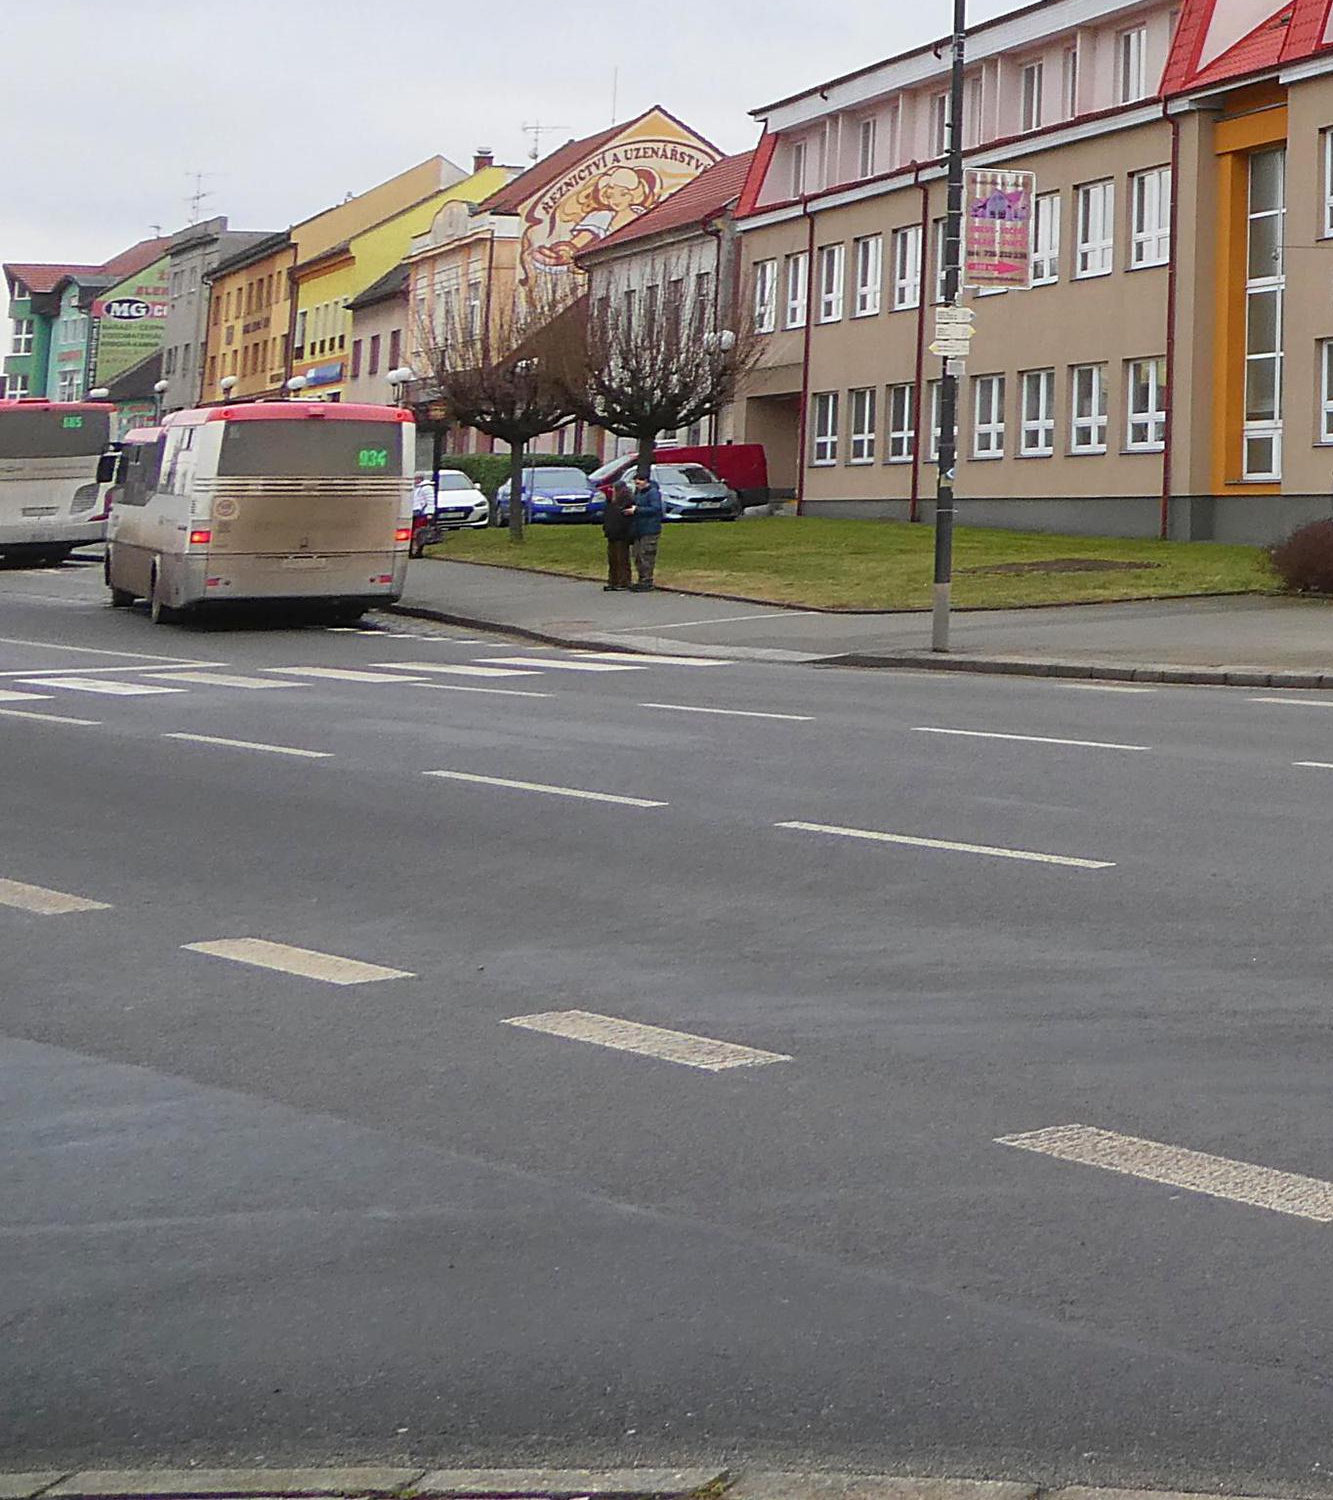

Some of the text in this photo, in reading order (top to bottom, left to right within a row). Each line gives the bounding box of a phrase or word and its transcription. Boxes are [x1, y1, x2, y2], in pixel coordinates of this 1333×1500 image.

[541, 151, 608, 215] ŘEZNICTVÍ
[611, 152, 621, 165] A
[110, 302, 148, 317] MG
